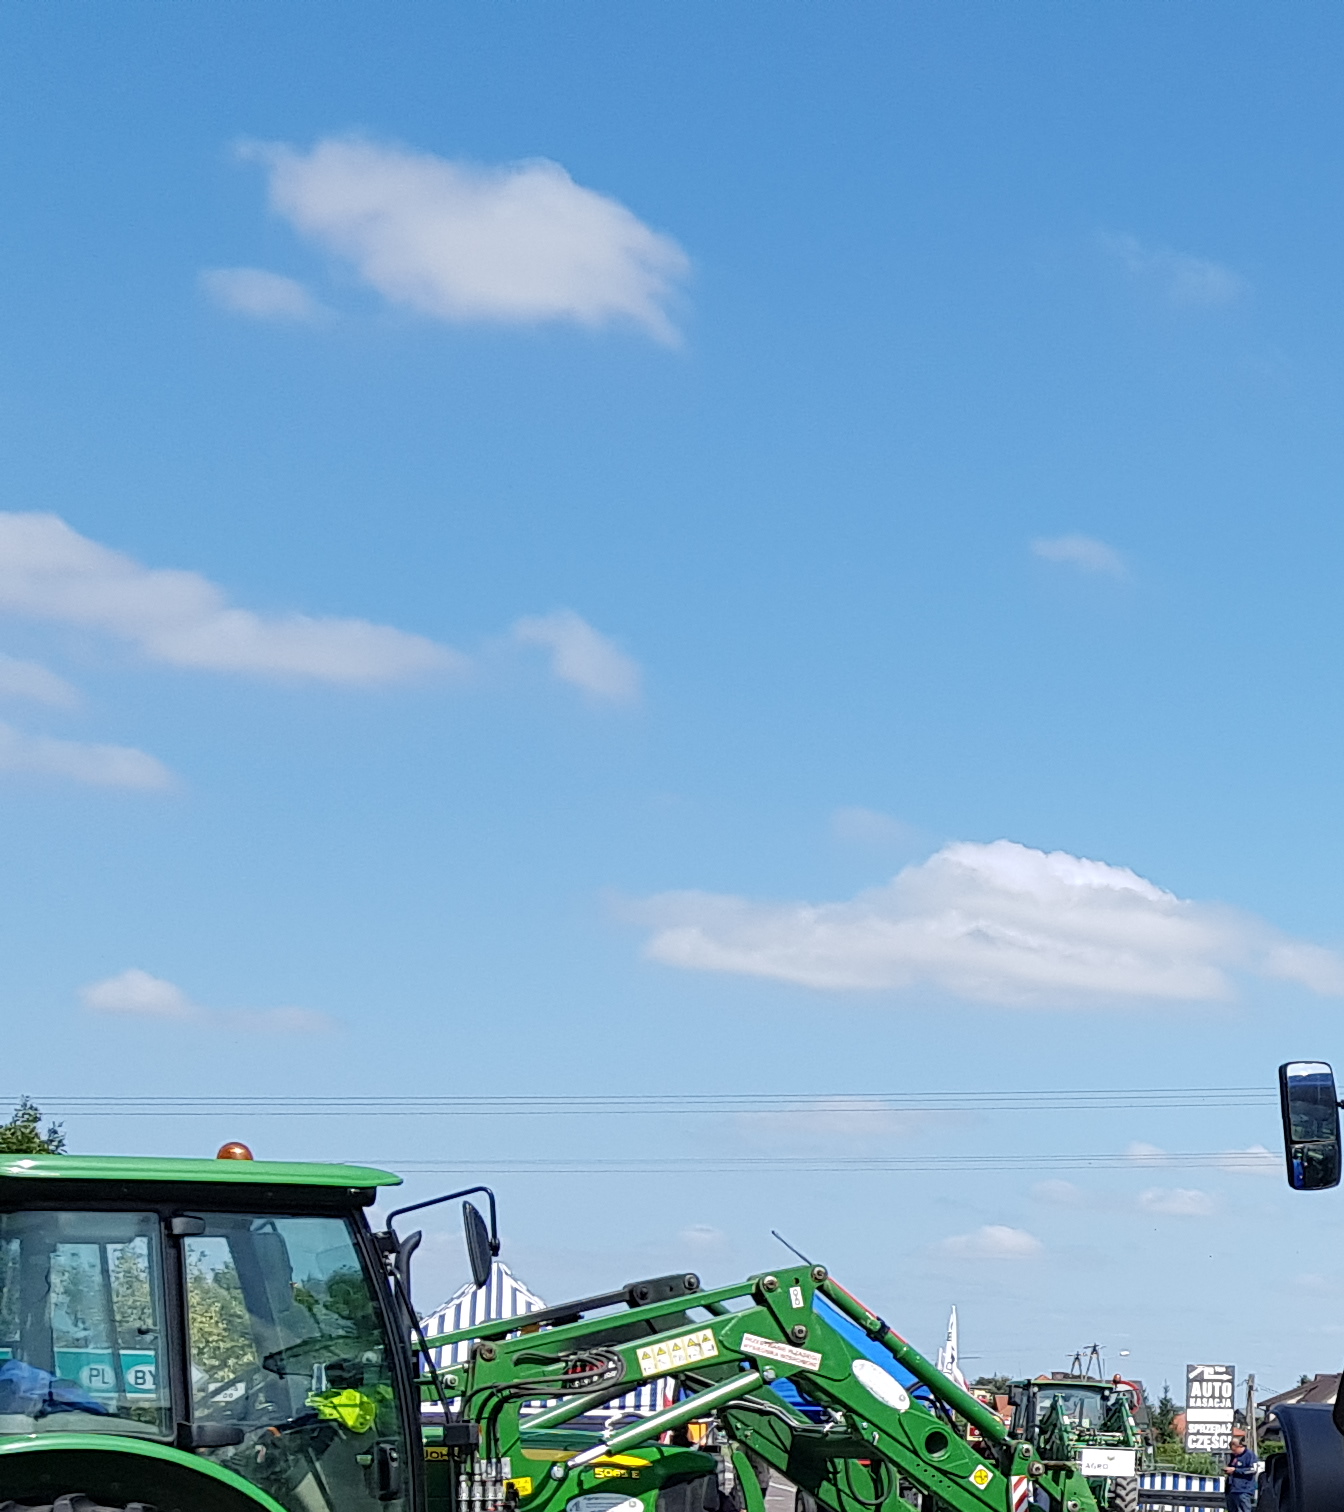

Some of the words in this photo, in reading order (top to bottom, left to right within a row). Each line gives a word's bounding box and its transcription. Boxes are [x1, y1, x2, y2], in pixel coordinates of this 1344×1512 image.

[88, 1367, 110, 1385] PL
[1190, 1381, 1232, 1398] AUTO
[1189, 1398, 1232, 1408] KASACJA
[1187, 1422, 1232, 1434] SPRZEDAŻ
